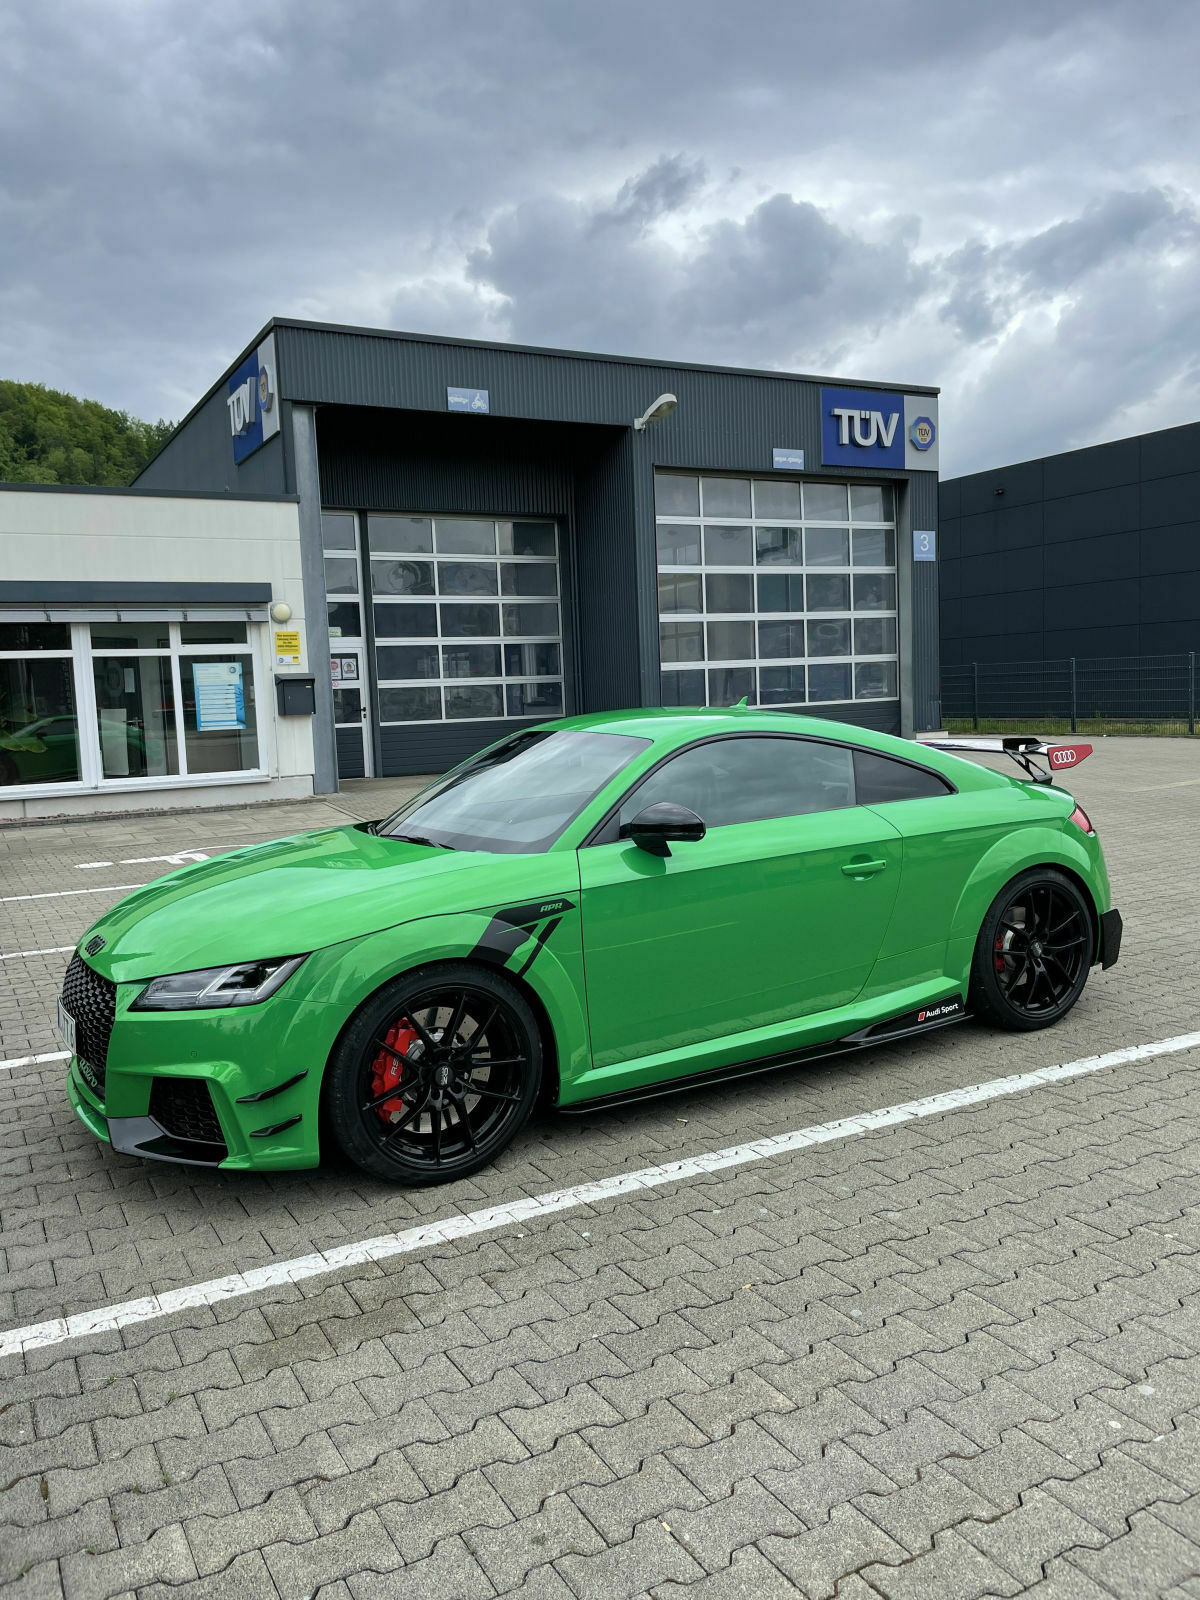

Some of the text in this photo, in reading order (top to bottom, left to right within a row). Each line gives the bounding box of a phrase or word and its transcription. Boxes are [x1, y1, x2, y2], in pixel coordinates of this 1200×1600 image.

[832, 408, 900, 448] TÜV
[920, 534, 929, 551] 3
[540, 902, 563, 913] APR
[926, 1003, 959, 1018] Audi Sport
